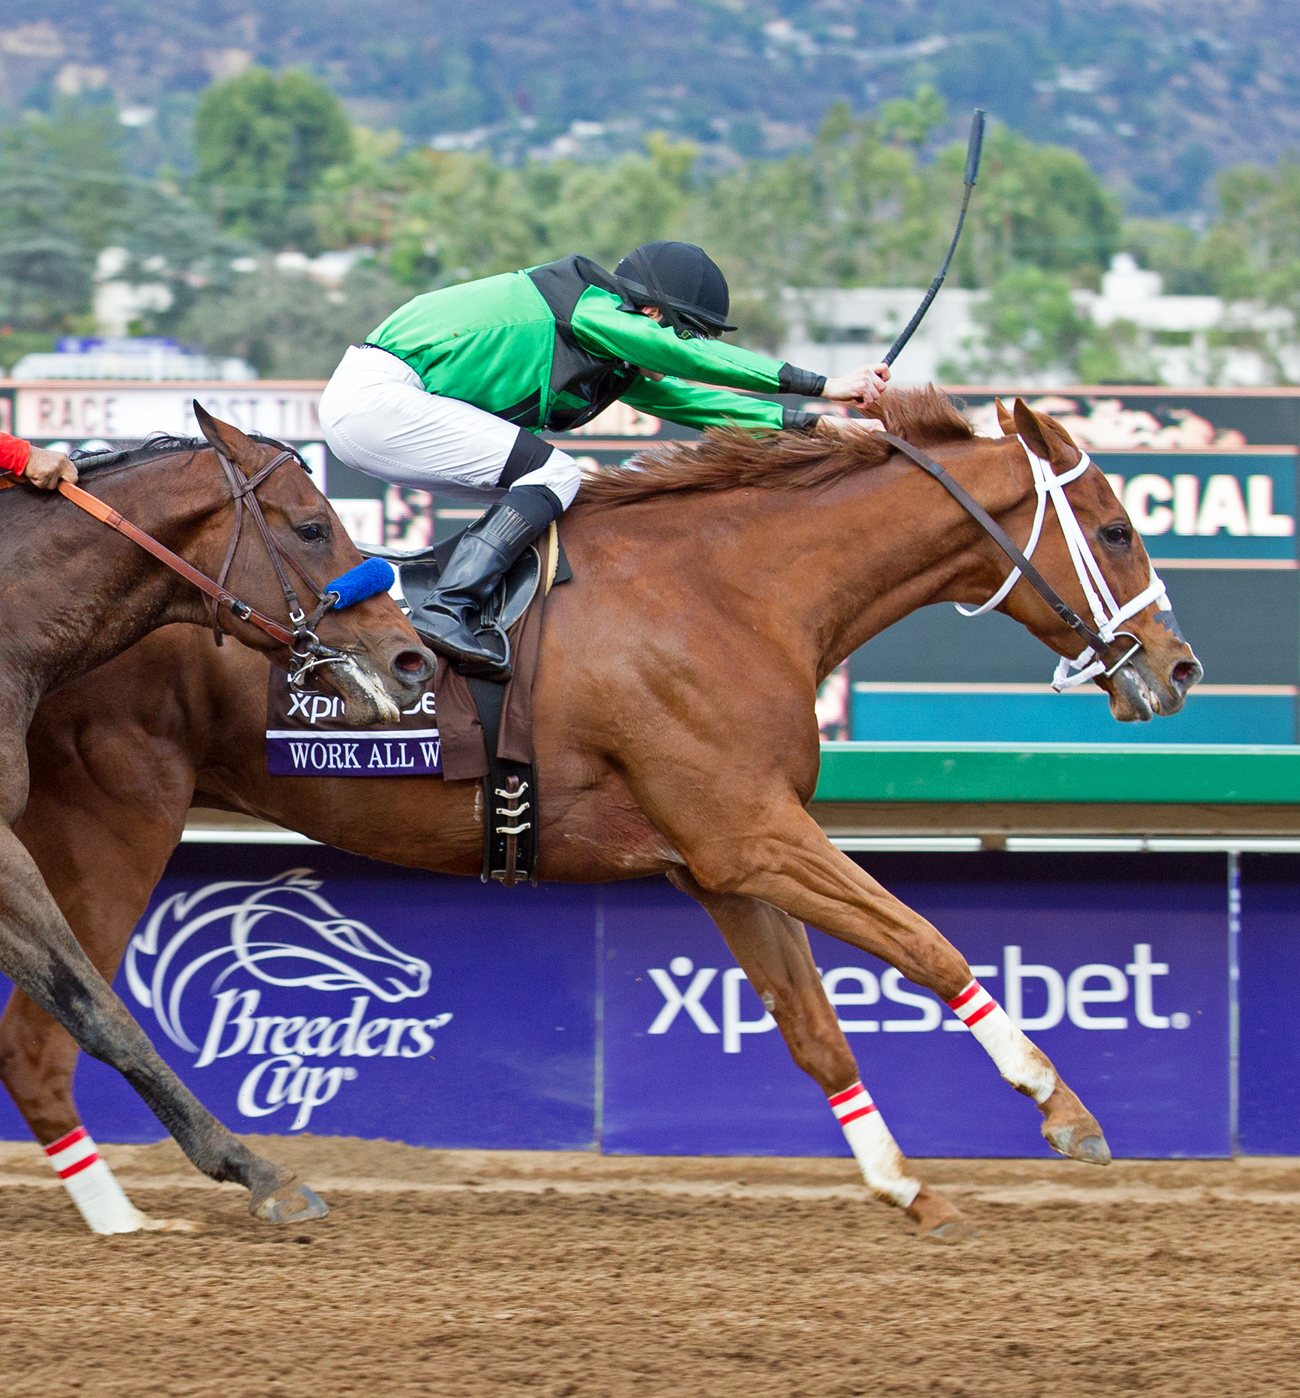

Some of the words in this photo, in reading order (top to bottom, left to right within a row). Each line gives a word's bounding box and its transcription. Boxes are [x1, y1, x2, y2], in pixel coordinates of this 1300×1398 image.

[38, 397, 116, 432] RACE
[288, 742, 362, 769] WORK
[367, 743, 414, 769] ALL
[237, 1054, 348, 1131] Cup
